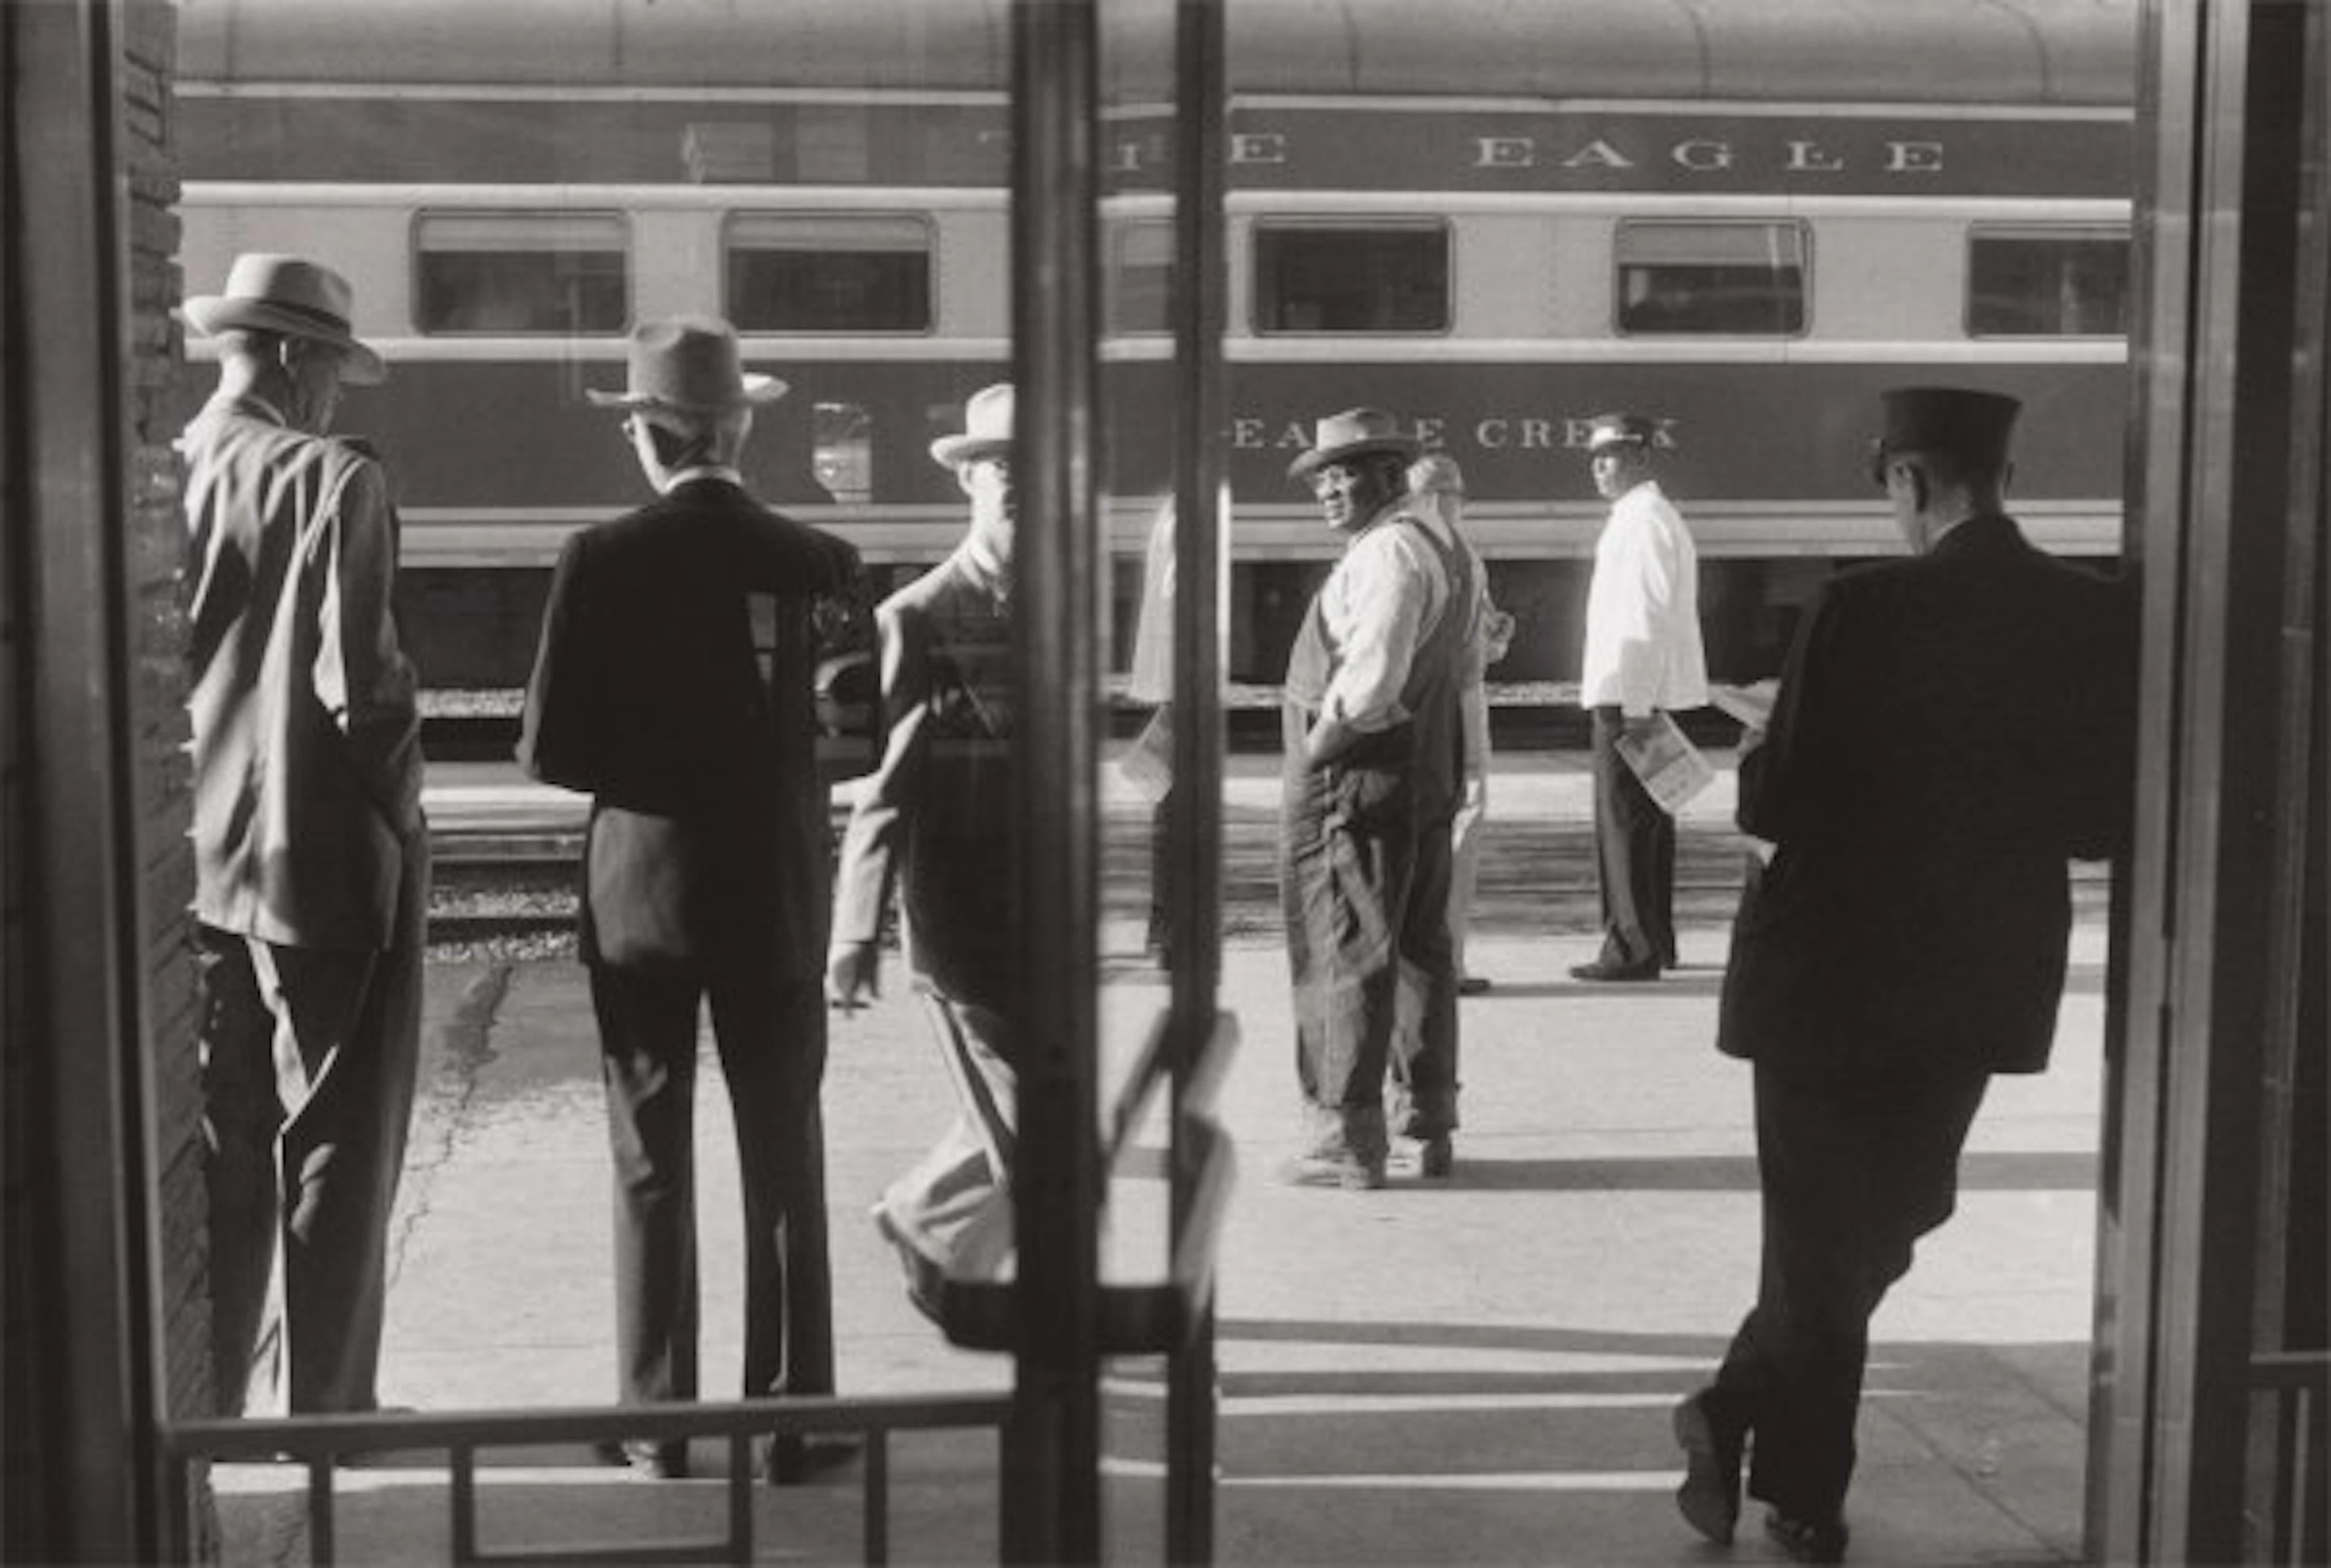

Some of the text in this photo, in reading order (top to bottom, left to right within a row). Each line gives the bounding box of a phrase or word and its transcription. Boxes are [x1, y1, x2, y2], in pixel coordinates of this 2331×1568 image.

[1474, 137, 1944, 171] EAGLE
[1232, 418, 1679, 448] EAE CREK
